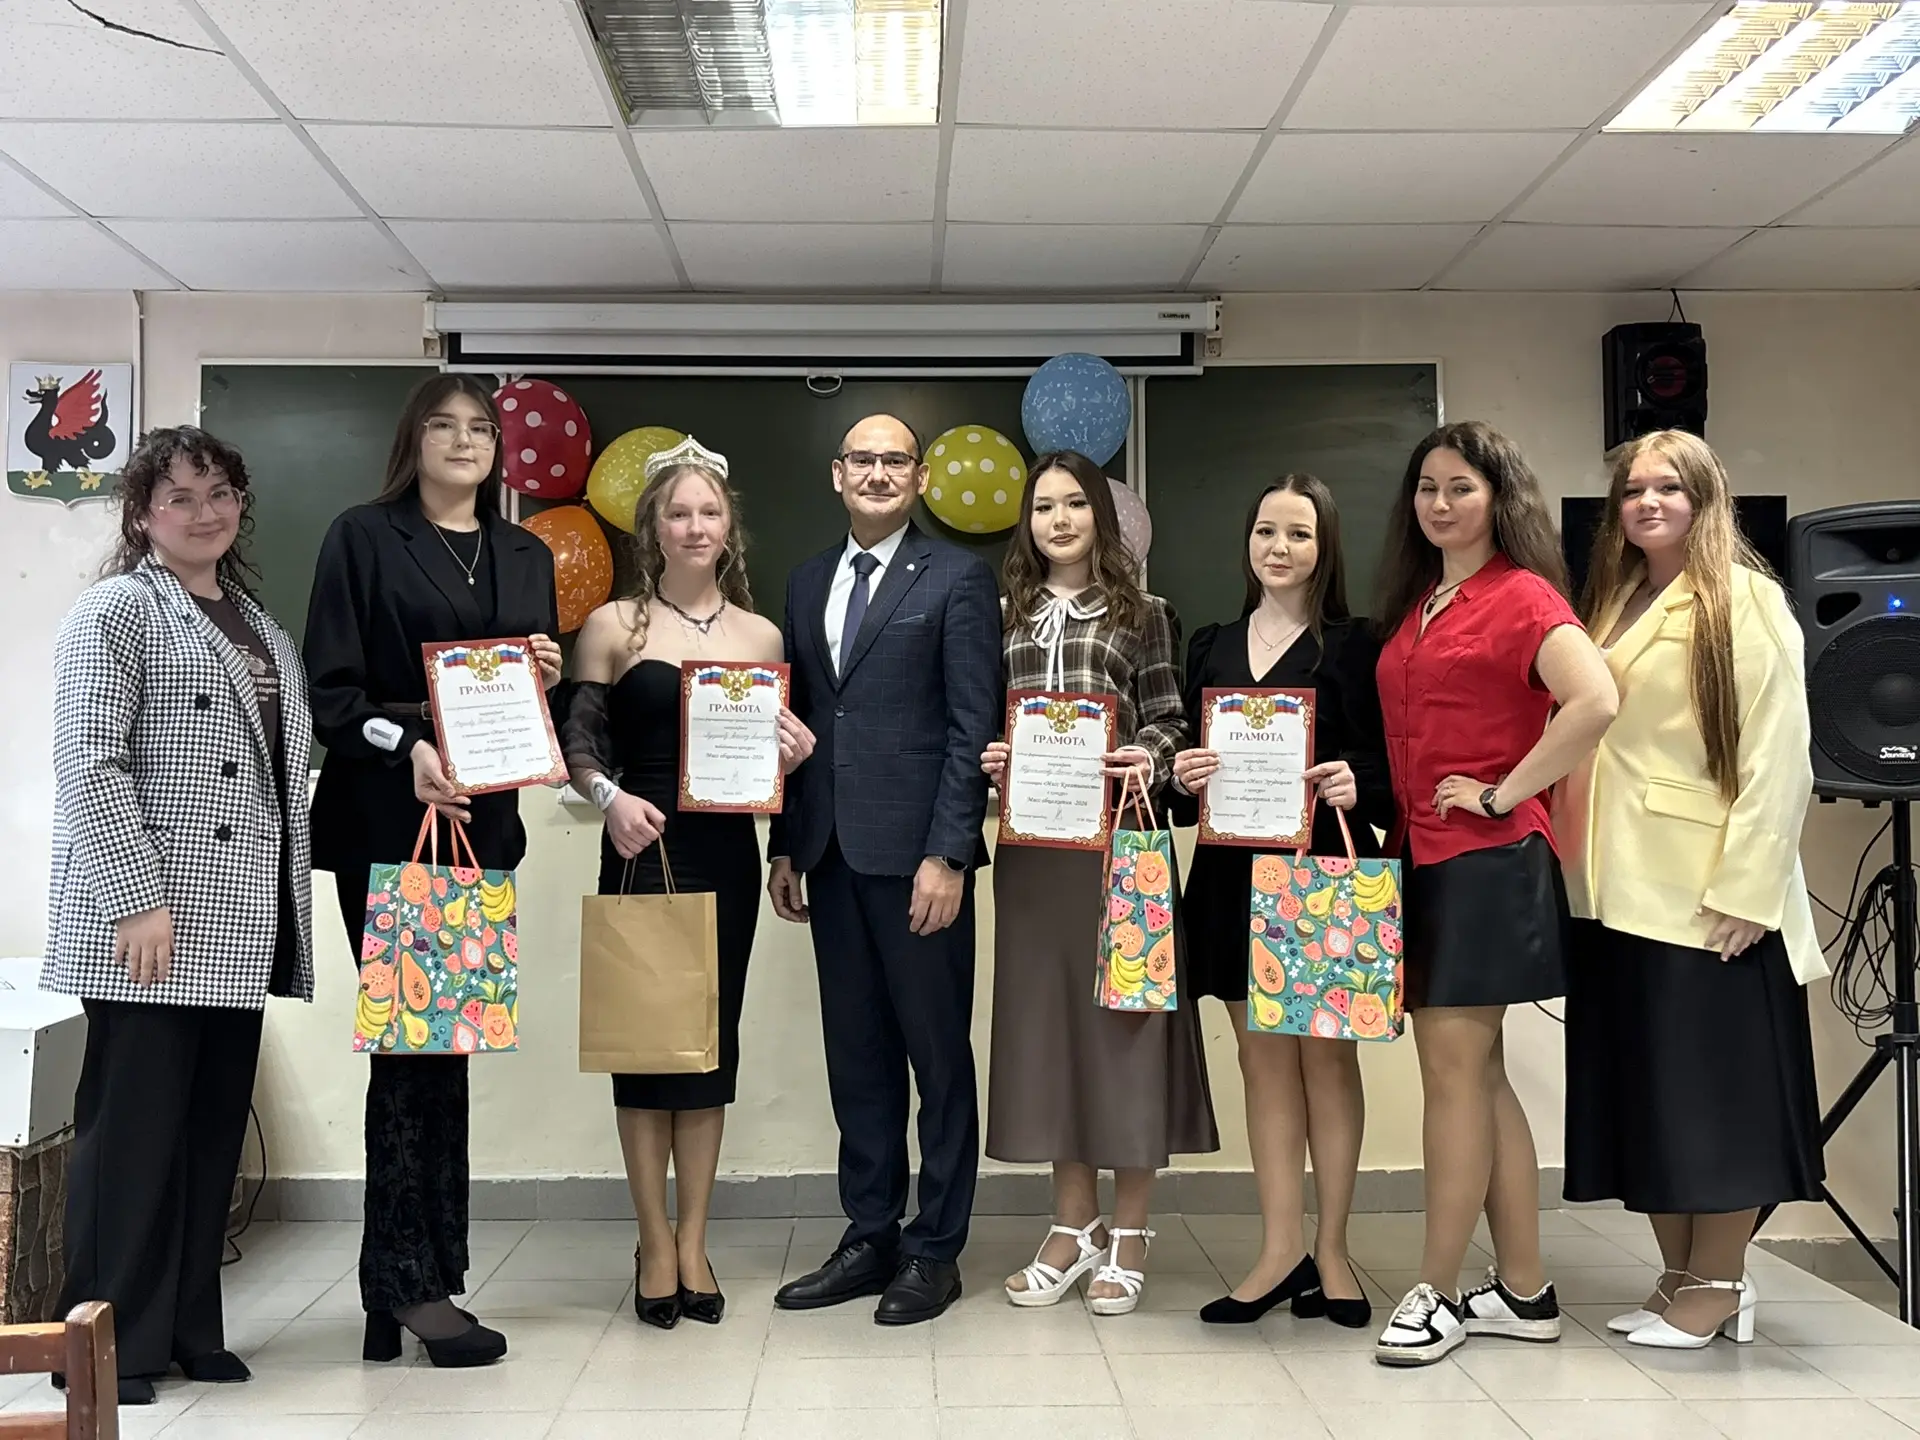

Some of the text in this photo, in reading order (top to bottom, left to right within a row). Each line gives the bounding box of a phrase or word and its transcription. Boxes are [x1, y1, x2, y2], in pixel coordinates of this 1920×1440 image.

[459, 683, 514, 695] ГРАМОТА
[709, 703, 761, 713] ГРАМОТА
[1033, 734, 1086, 746] ГРАМОТА
[1229, 731, 1284, 742] ГРАМОТА
